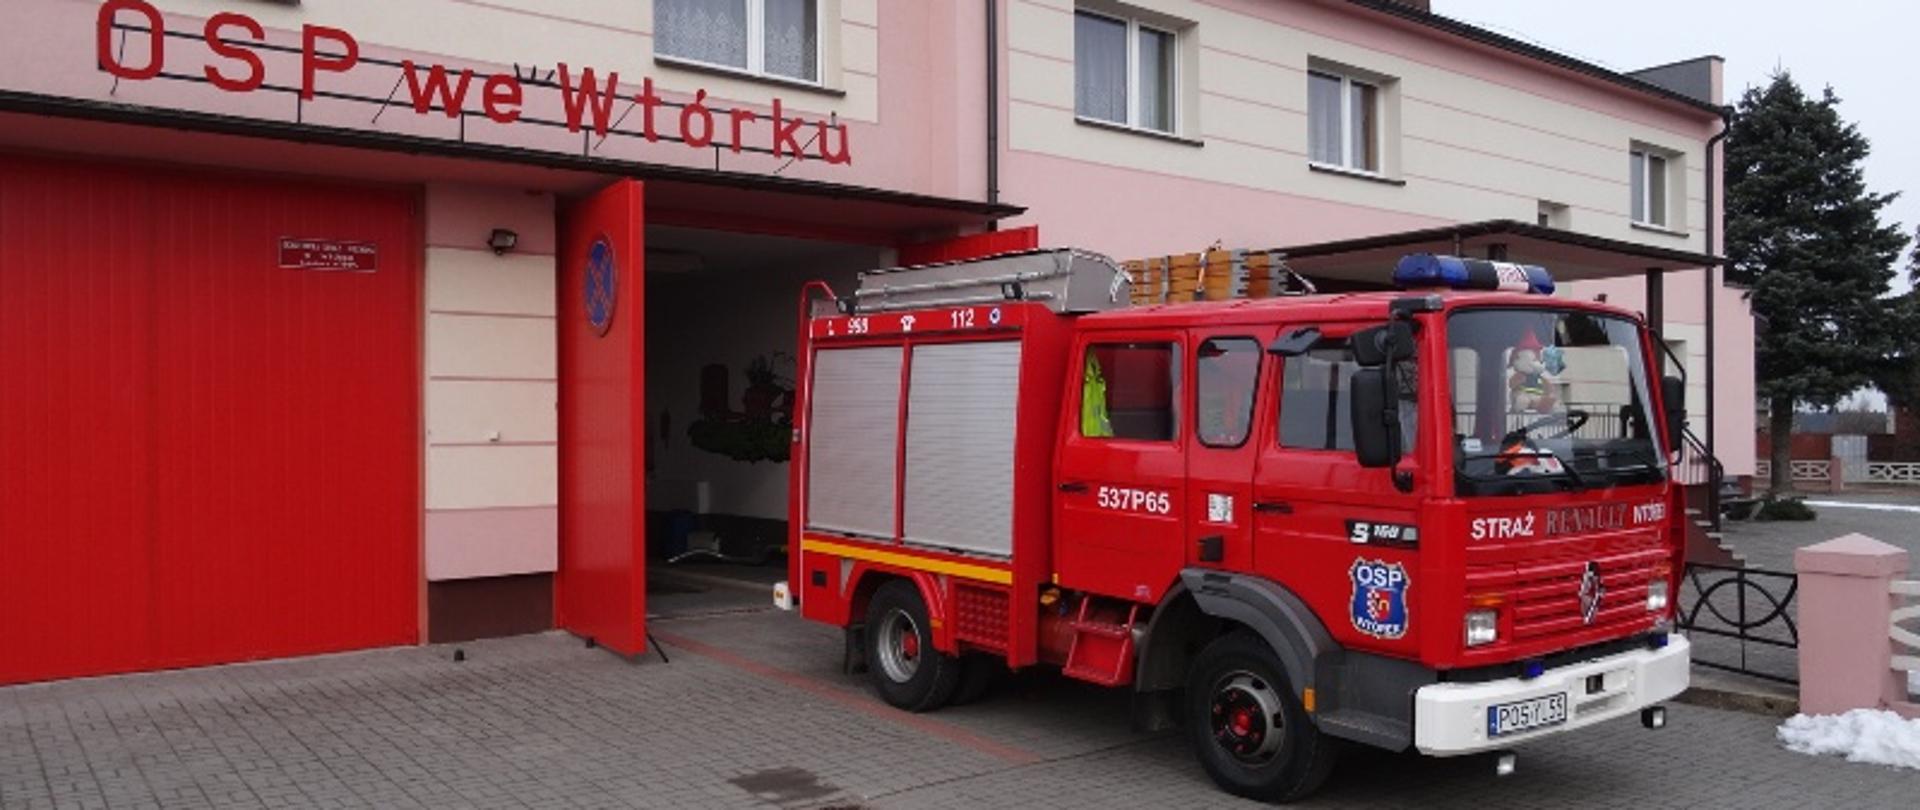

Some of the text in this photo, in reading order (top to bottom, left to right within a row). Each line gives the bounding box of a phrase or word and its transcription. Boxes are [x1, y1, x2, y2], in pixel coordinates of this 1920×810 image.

[97, 0, 853, 167] OSP we Wtórku
[951, 308, 975, 328] 112
[1098, 486, 1171, 515] 537P65
[1470, 511, 1536, 540] STRAŻ
[1546, 504, 1628, 535] RENAULT
[1356, 565, 1402, 588] OSP
